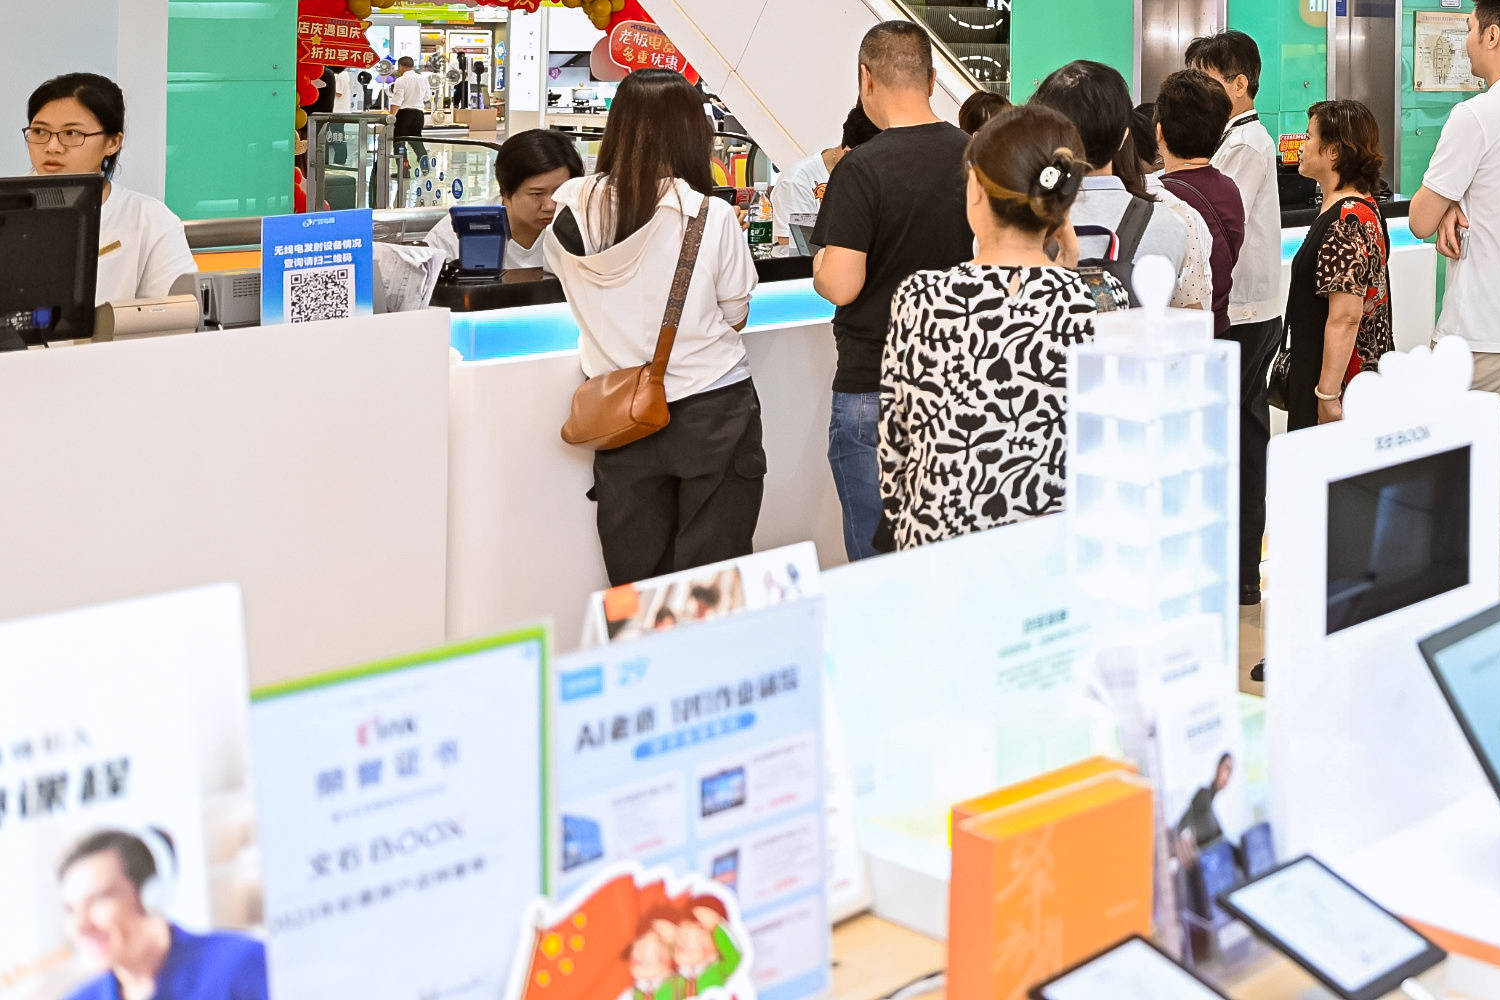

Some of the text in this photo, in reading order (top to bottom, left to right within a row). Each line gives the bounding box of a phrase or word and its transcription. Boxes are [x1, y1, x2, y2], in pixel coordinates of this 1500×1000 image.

[298, 21, 361, 39] 店庆遇国庆
[618, 29, 676, 54] 老板电器
[311, 45, 375, 63] 折扣享不停
[622, 46, 679, 71] 多重优惠
[273, 238, 363, 256] 无线电发射设备情况
[283, 252, 353, 269] 查询请扫二维码
